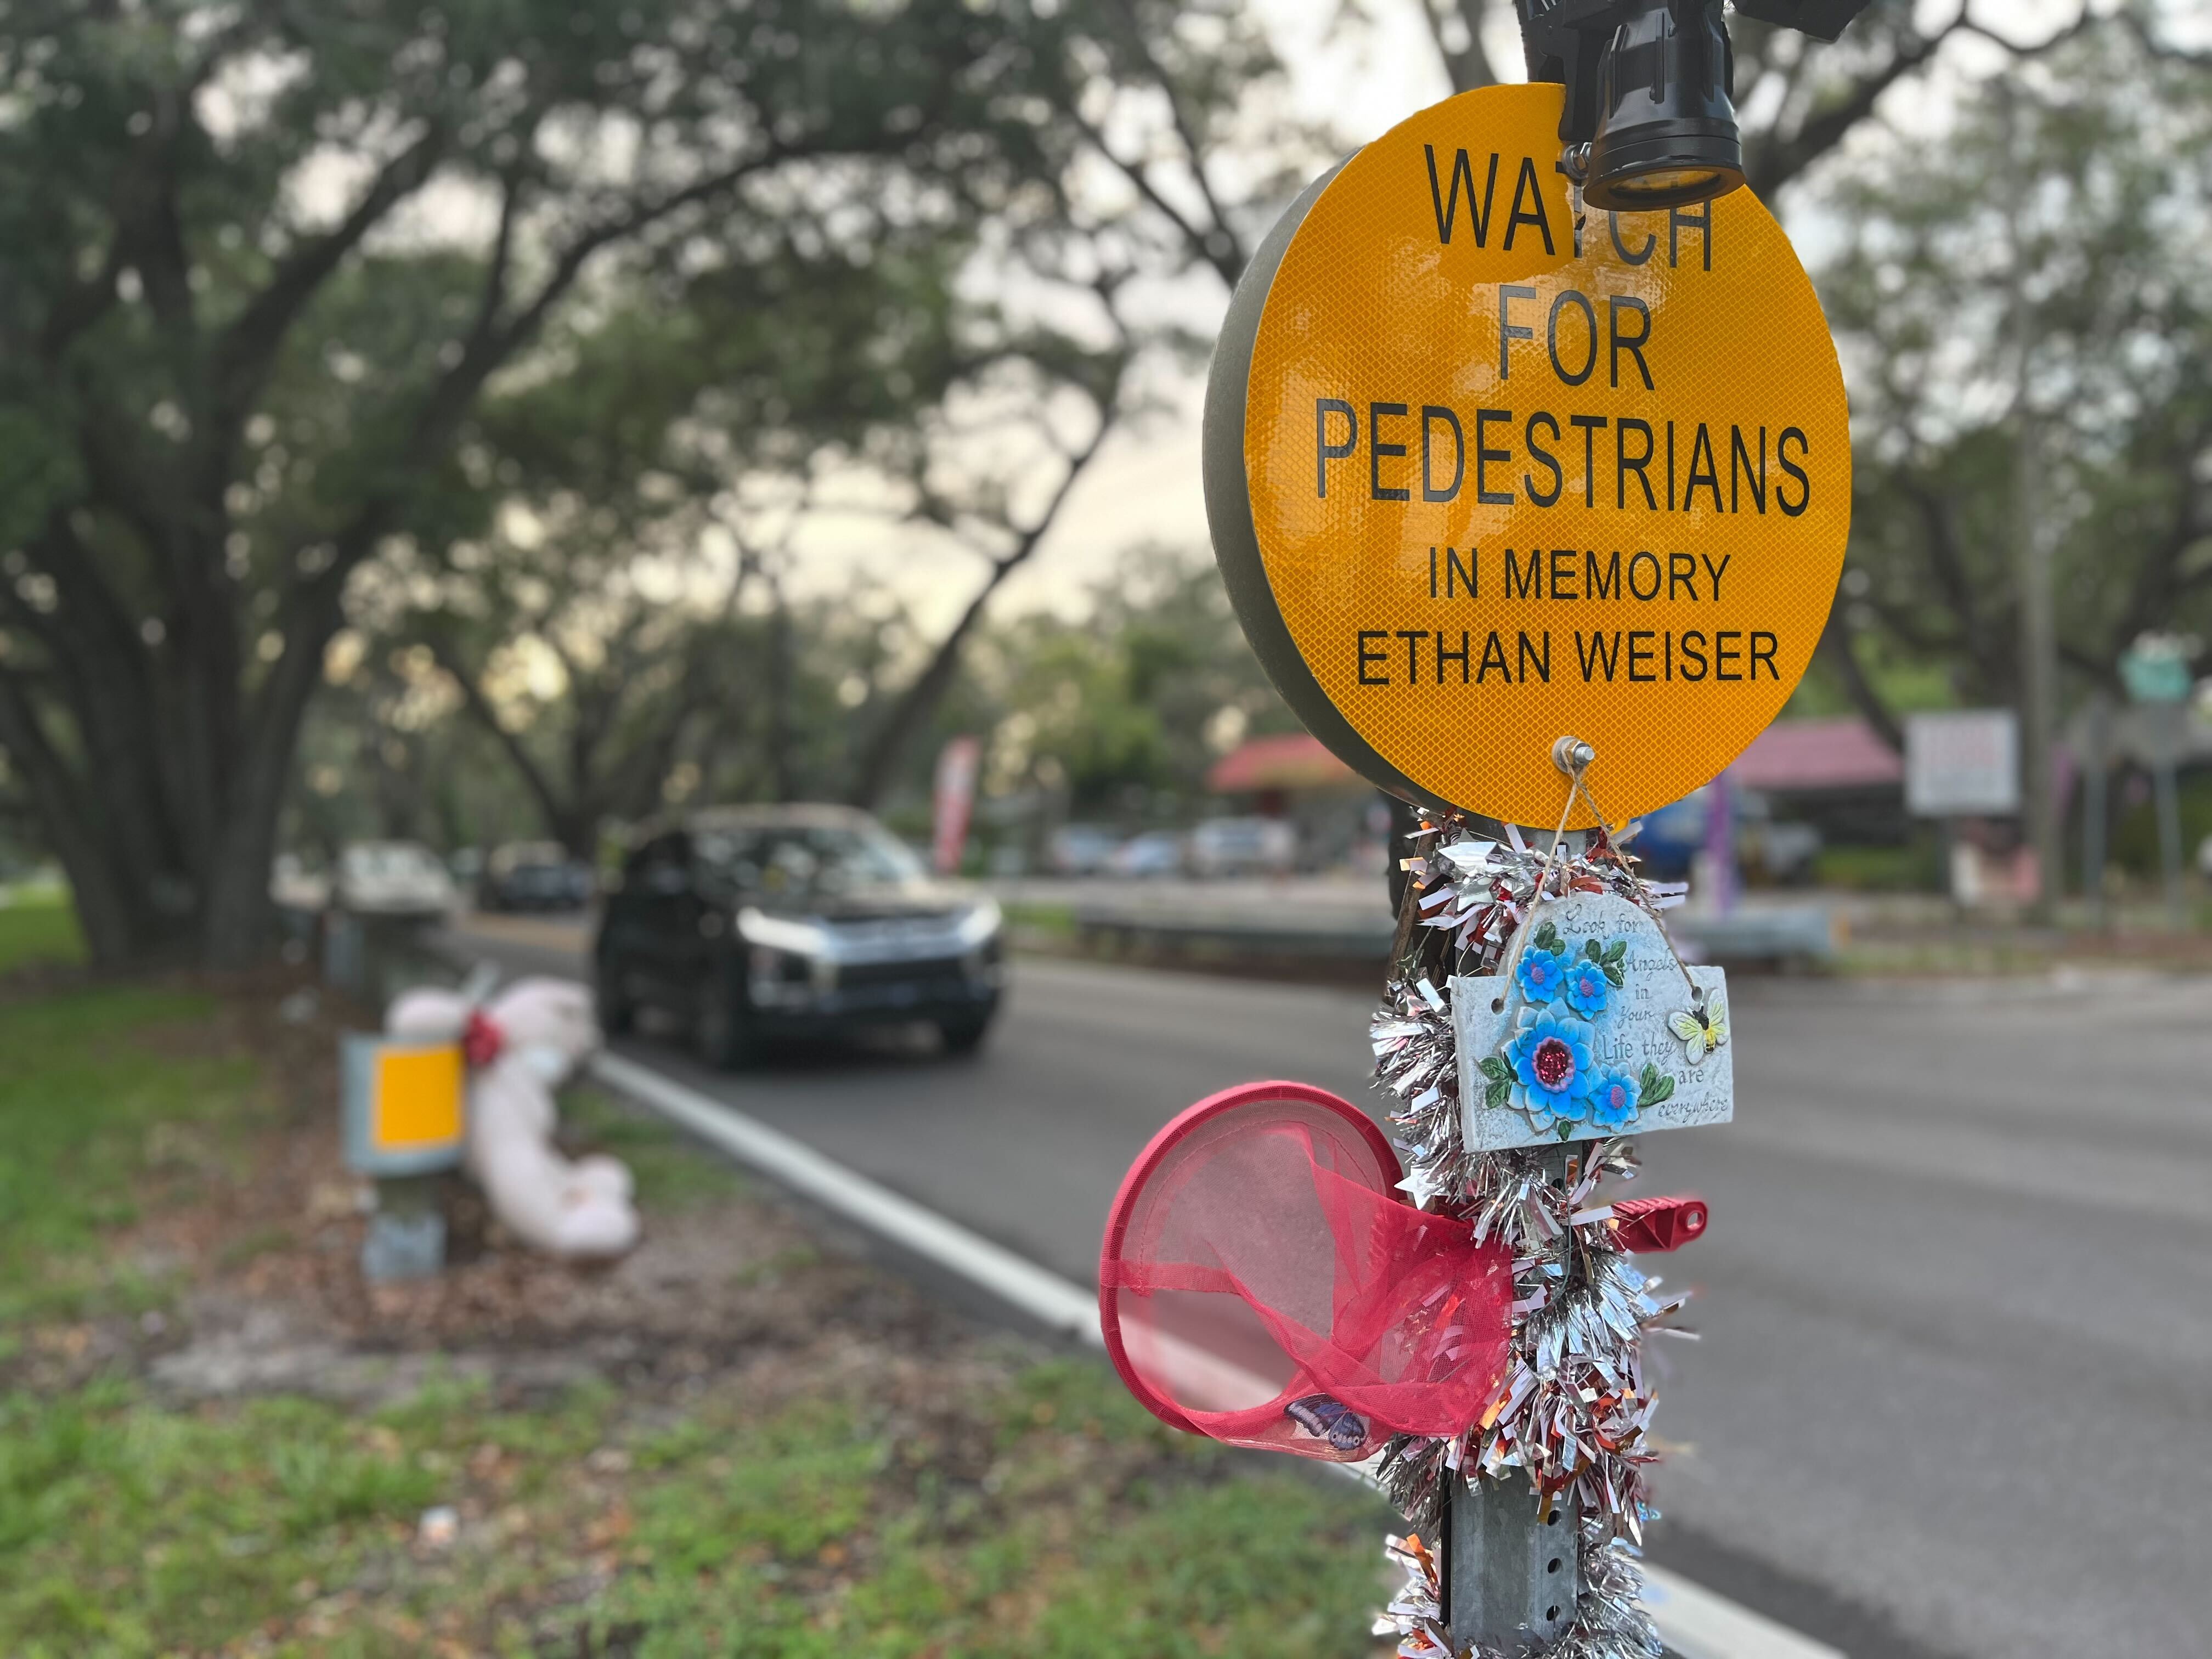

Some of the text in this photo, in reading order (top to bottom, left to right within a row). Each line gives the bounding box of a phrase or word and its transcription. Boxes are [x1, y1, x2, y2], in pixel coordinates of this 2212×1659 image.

[1424, 144, 1711, 271] WATCH
[1499, 284, 1655, 391] FOR
[1316, 398, 1810, 517] PEDESTRIANS
[1430, 547, 1731, 602] IN MEMORY
[1357, 631, 1780, 685] ETHAN WEISER
[1563, 904, 1644, 940] Look for
[1623, 947, 1678, 981] Angels
[1635, 984, 1650, 1000] in
[1602, 1032, 1677, 1065] Life they
[1679, 1069, 1705, 1085] are
[1658, 1092, 1729, 1124] everywhere
